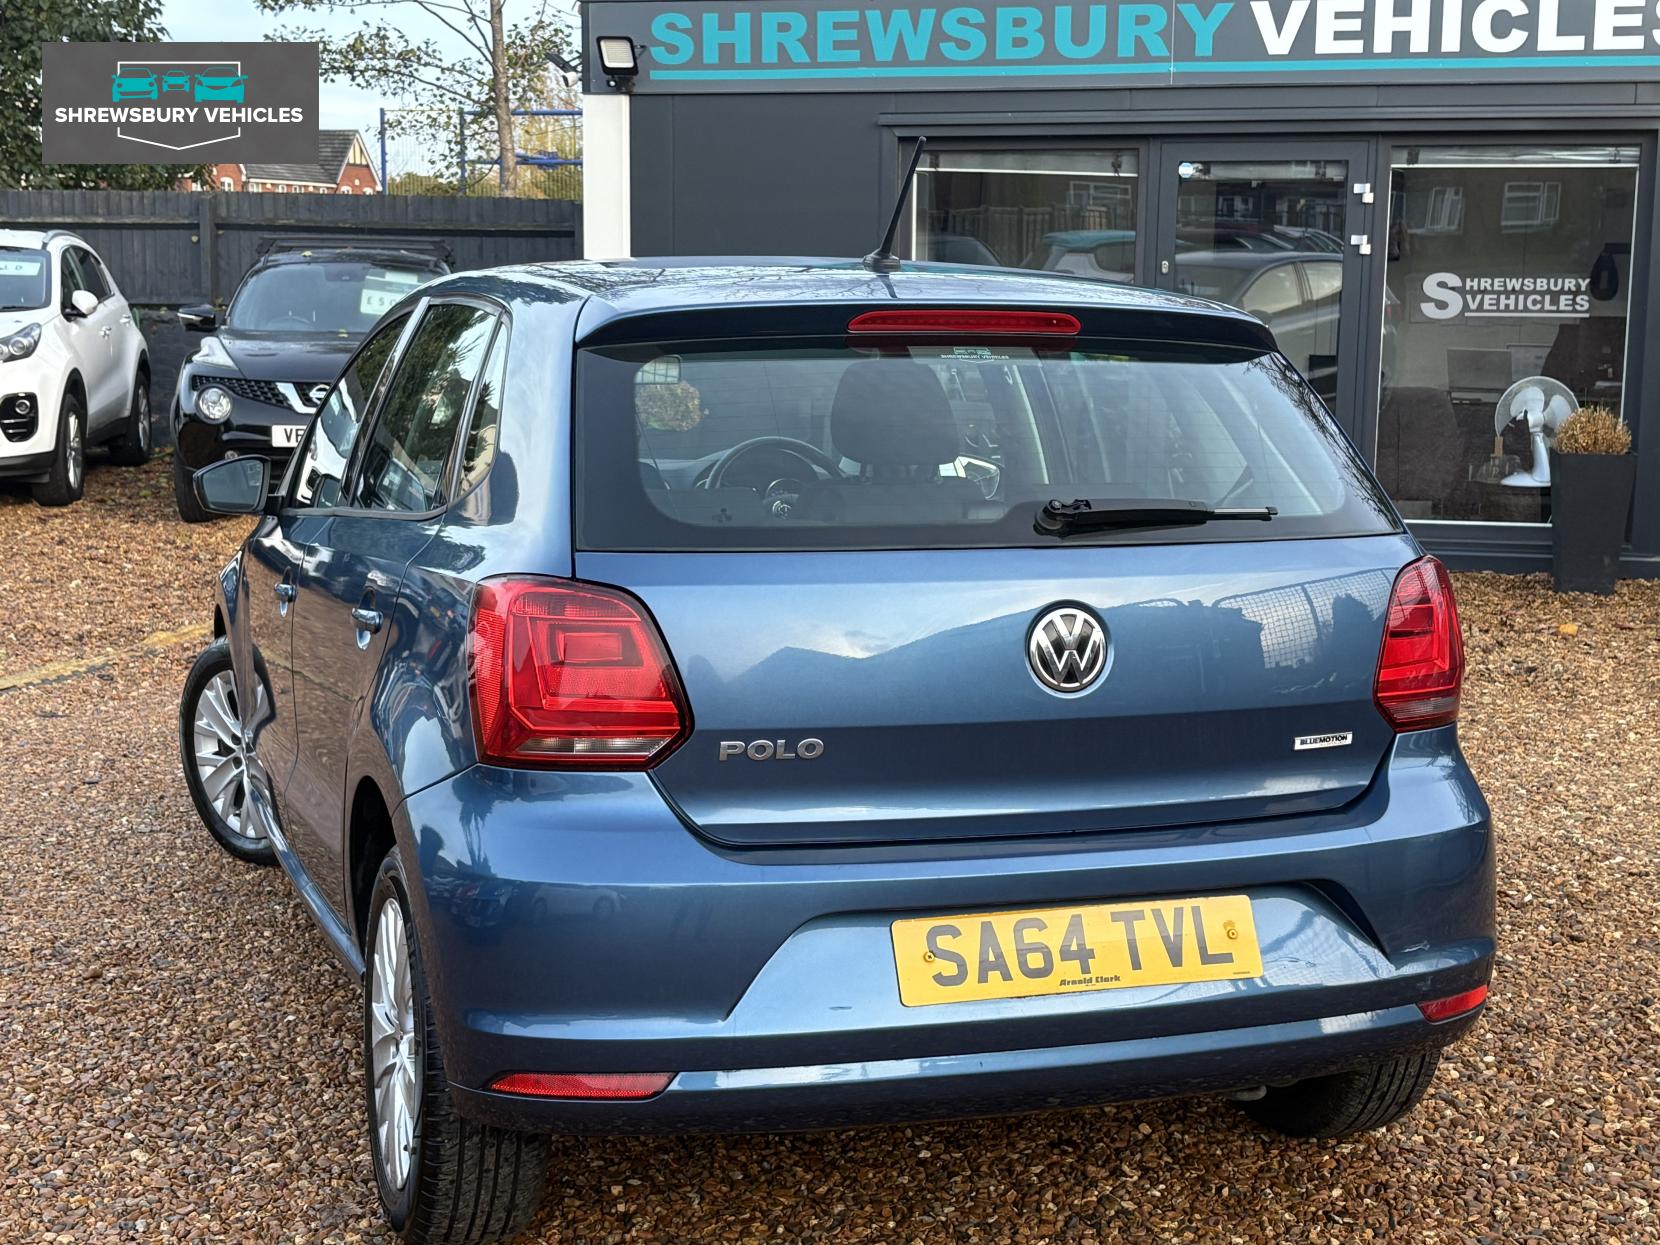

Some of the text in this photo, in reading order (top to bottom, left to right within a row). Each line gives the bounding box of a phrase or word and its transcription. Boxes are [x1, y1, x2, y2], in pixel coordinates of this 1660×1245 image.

[650, 0, 1660, 65] SHREWSBURY VEHICLE
[1420, 272, 1591, 320] SHREWSBURY
[1465, 294, 1590, 311] VEHICLES
[719, 738, 824, 761] POLO
[1300, 734, 1348, 746] BLUEMOTION
[926, 905, 1235, 987] SA64 TVL
